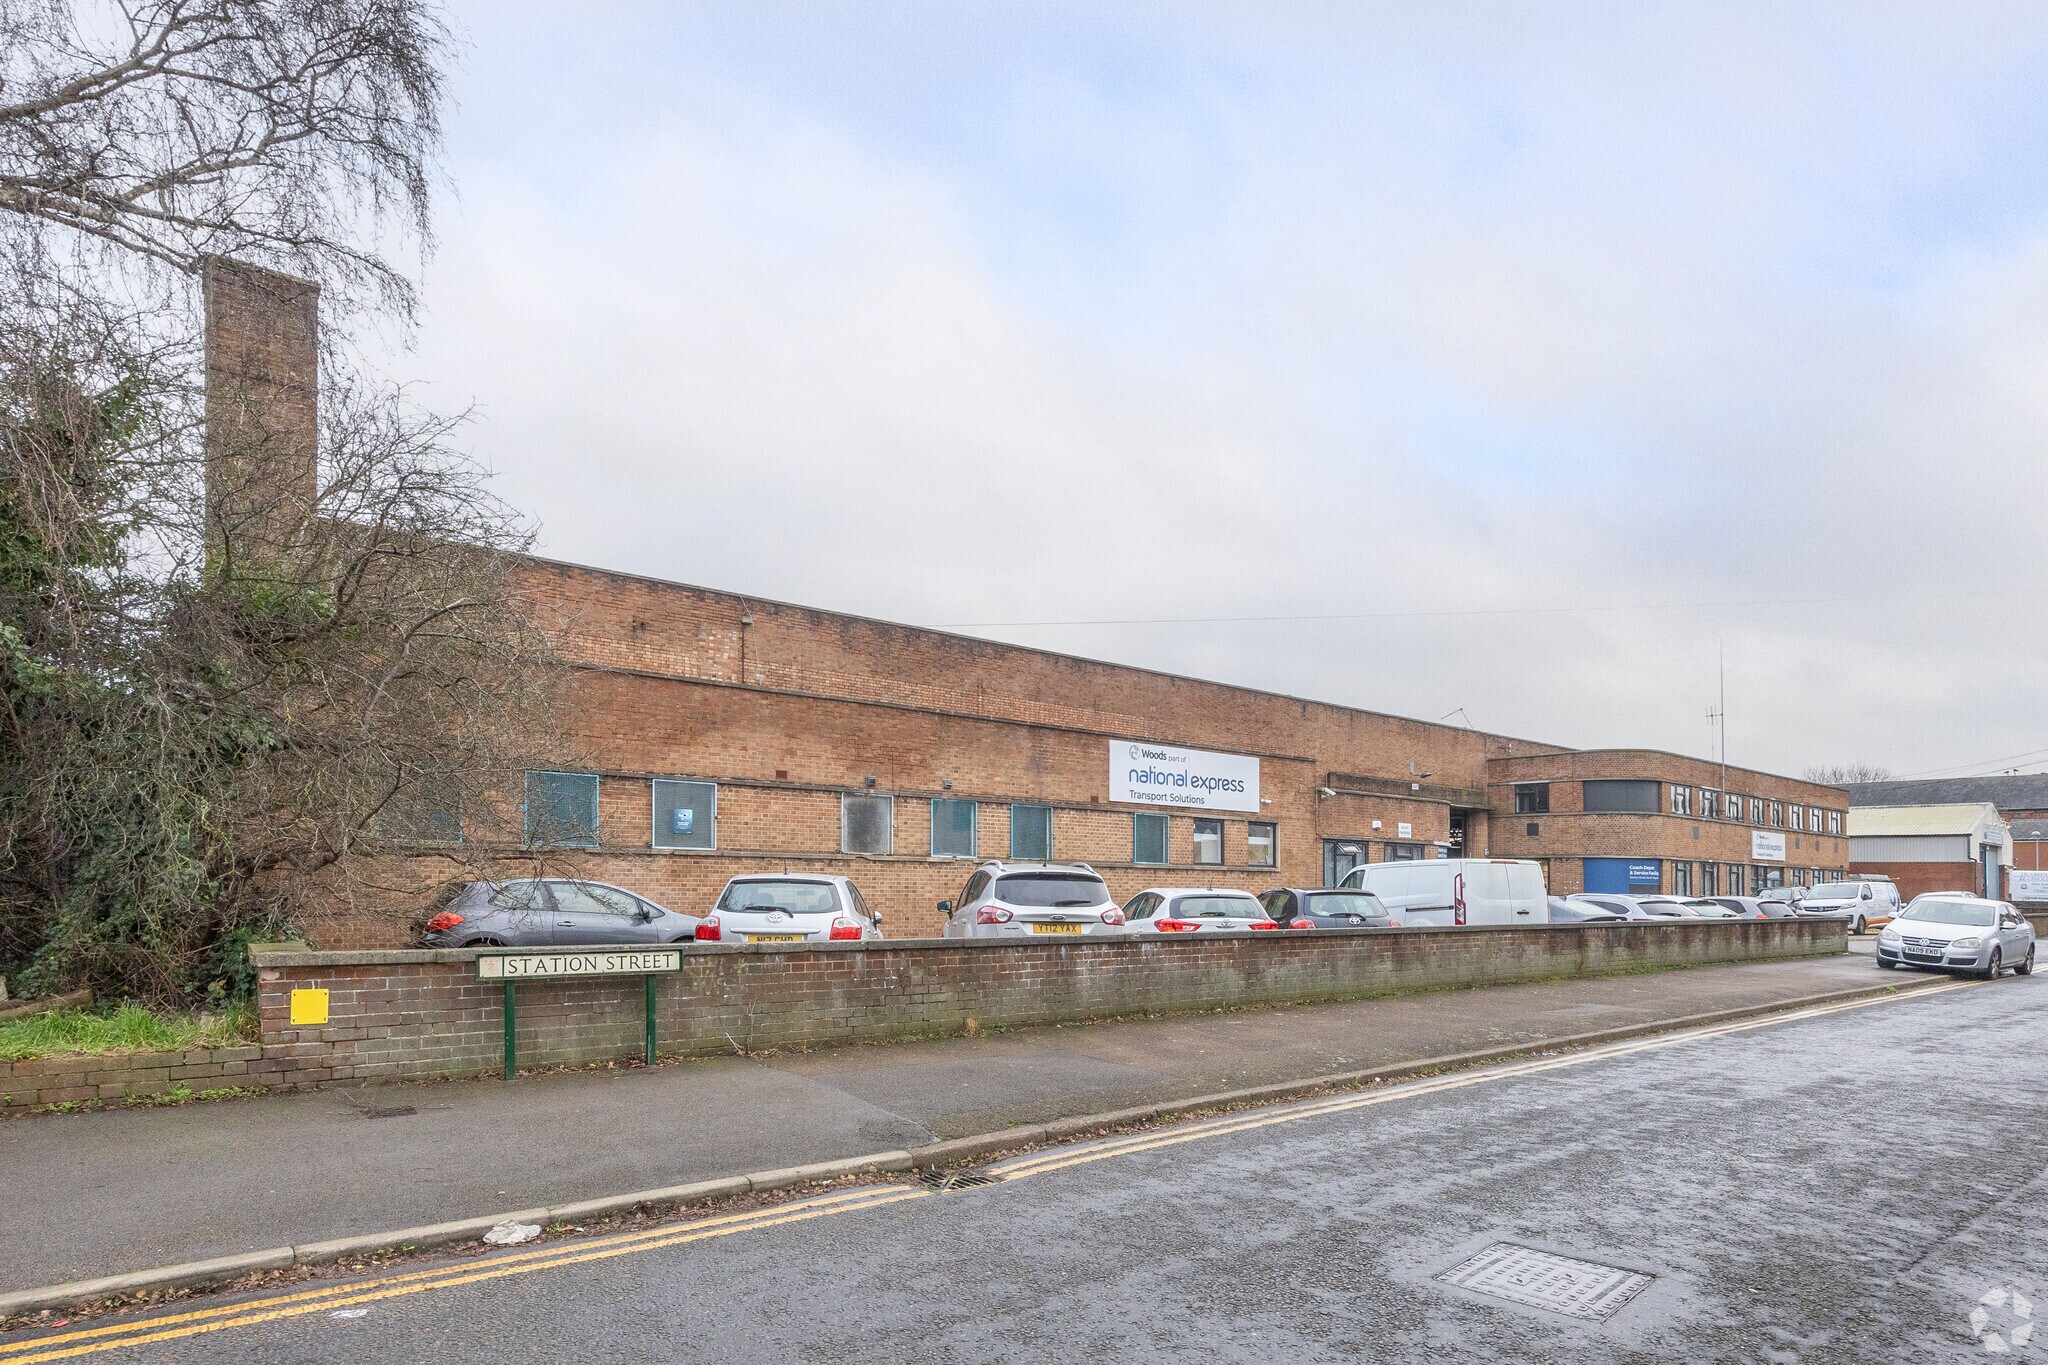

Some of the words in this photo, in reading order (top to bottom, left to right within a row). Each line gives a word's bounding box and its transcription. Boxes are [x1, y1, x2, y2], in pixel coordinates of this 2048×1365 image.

[1141, 748, 1167, 761] Woods
[1168, 755, 1180, 763] part
[1129, 765, 1188, 787] national
[1190, 775, 1245, 794] express
[1129, 789, 1168, 802] Transport
[1169, 792, 1205, 805] Solutions
[1039, 923, 1058, 932] YT12
[1060, 923, 1077, 933] YAX
[1907, 946, 1924, 954] NA09
[507, 956, 598, 974] STATION
[606, 953, 674, 970] STREET
